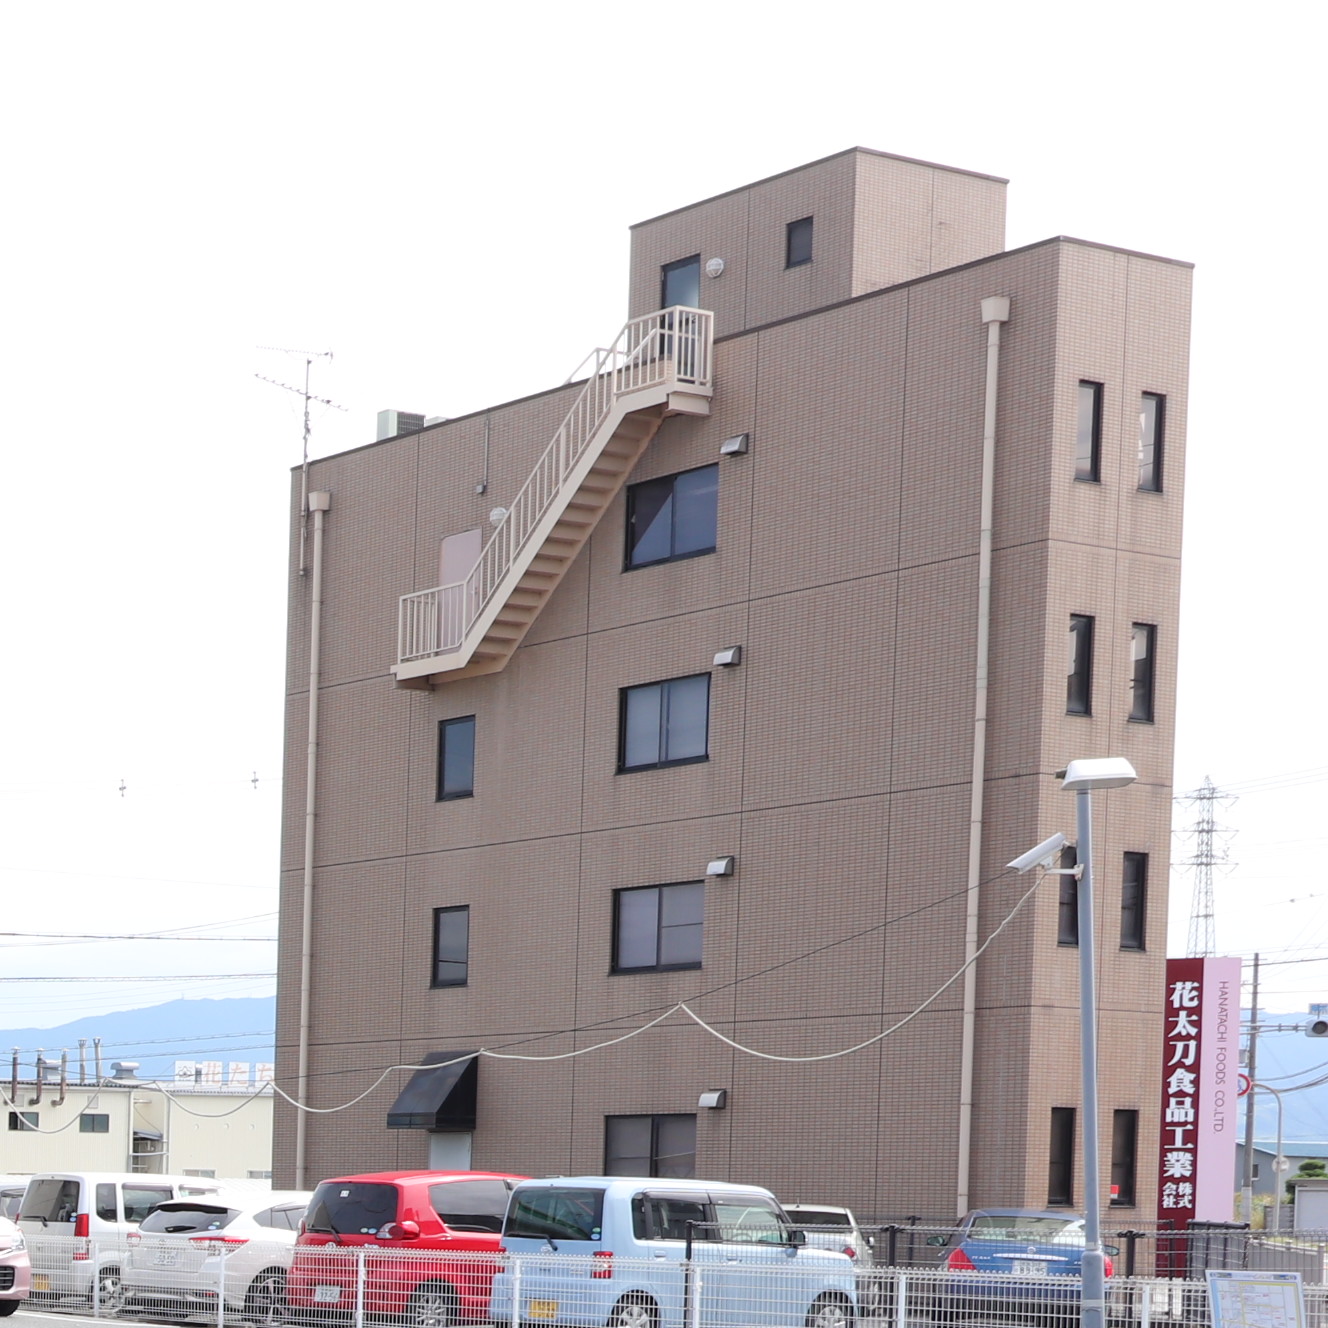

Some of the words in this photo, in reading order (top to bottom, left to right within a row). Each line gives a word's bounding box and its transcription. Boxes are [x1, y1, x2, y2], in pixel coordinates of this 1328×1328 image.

[1217, 980, 1228, 1042] HANATACHI
[1163, 980, 1200, 1178] 花太刀食品工業
[1215, 1047, 1227, 1085] FOODS
